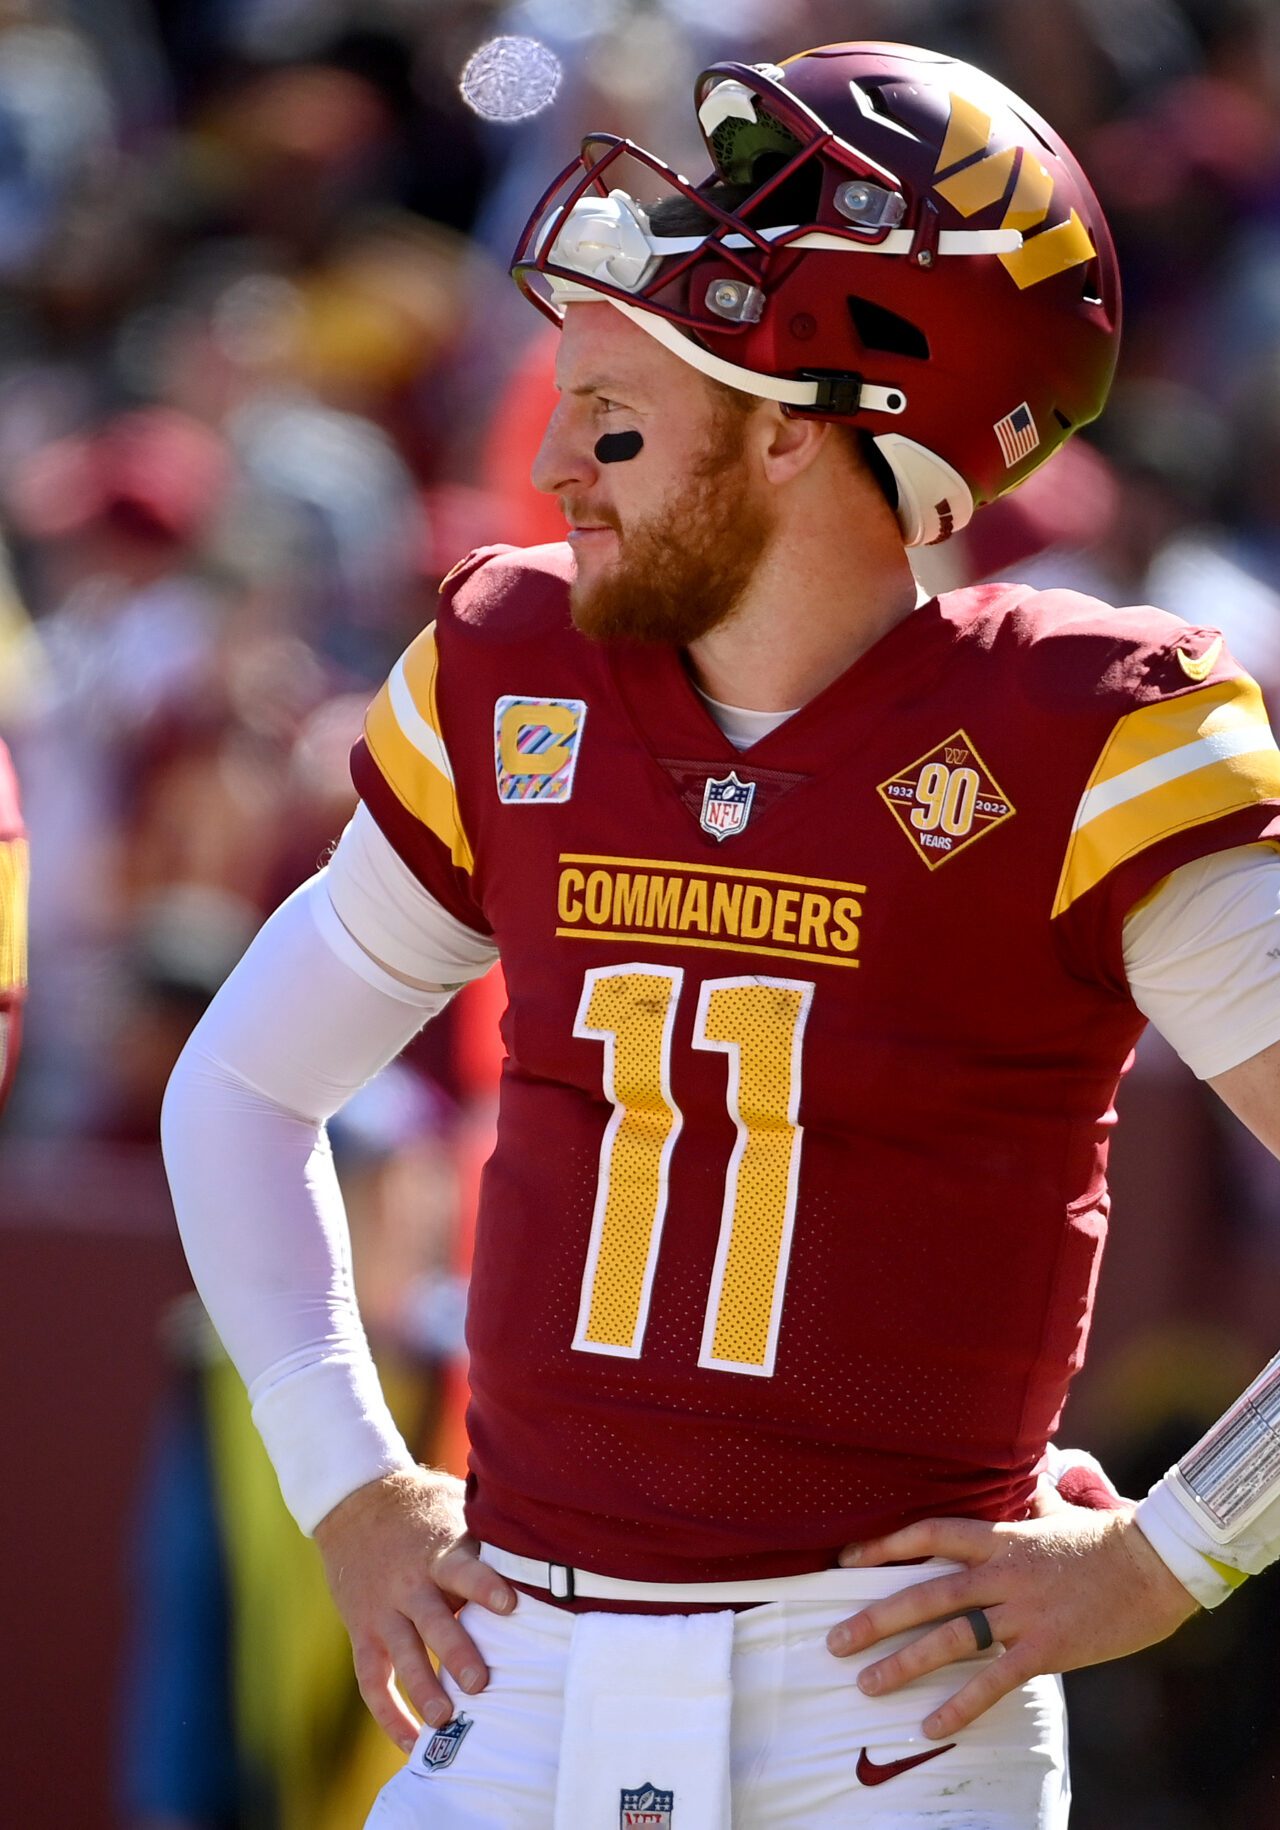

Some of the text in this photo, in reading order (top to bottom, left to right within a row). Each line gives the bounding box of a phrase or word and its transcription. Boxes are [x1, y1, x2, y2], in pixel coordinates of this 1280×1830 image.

[500, 703, 580, 776] C
[887, 784, 914, 798] 1932
[910, 762, 980, 836] 90
[708, 802, 739, 828] NFL
[975, 800, 1008, 815] 2022
[919, 832, 953, 850] YEARS
[557, 868, 862, 952] COMMANDERS
[571, 961, 816, 1378] 11
[427, 1737, 453, 1761] NFL
